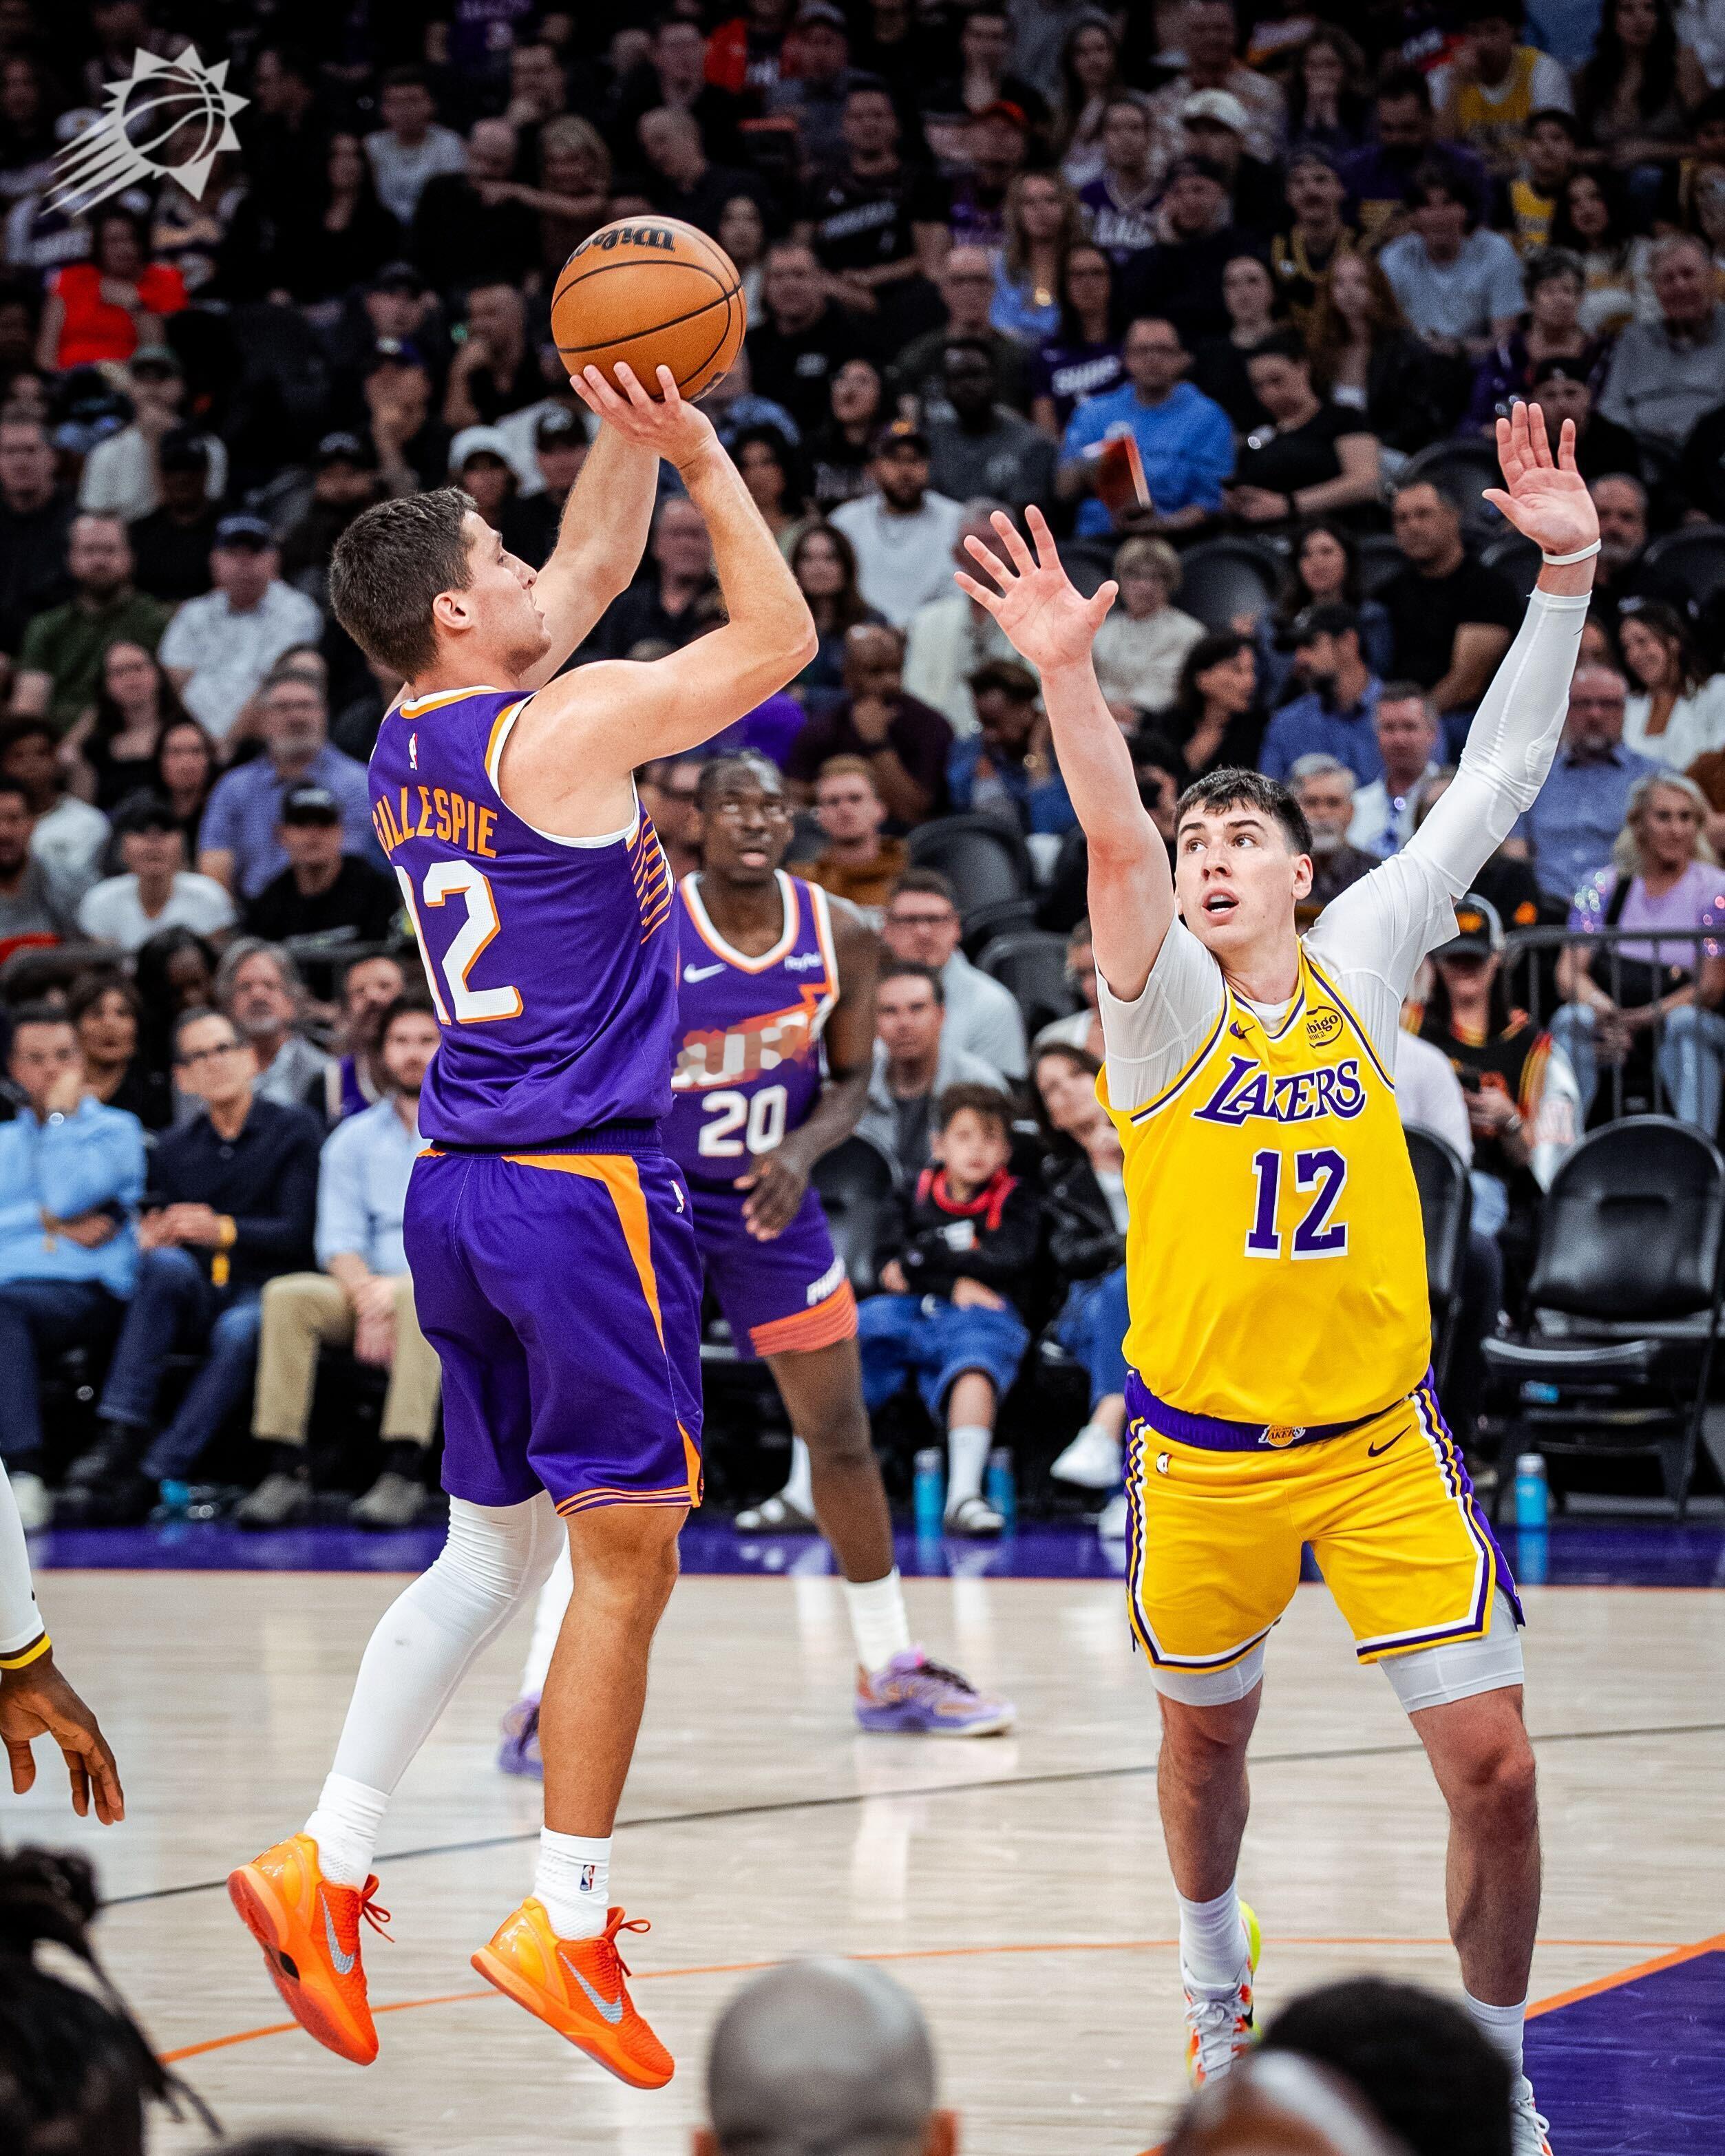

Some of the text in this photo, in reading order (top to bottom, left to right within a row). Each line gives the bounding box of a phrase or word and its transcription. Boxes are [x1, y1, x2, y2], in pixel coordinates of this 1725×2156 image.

[1306, 1015, 1339, 1034] bigo
[698, 1085, 787, 1157] 20
[1191, 1053, 1368, 1128] LAKERS
[1244, 1146, 1348, 1261] 12
